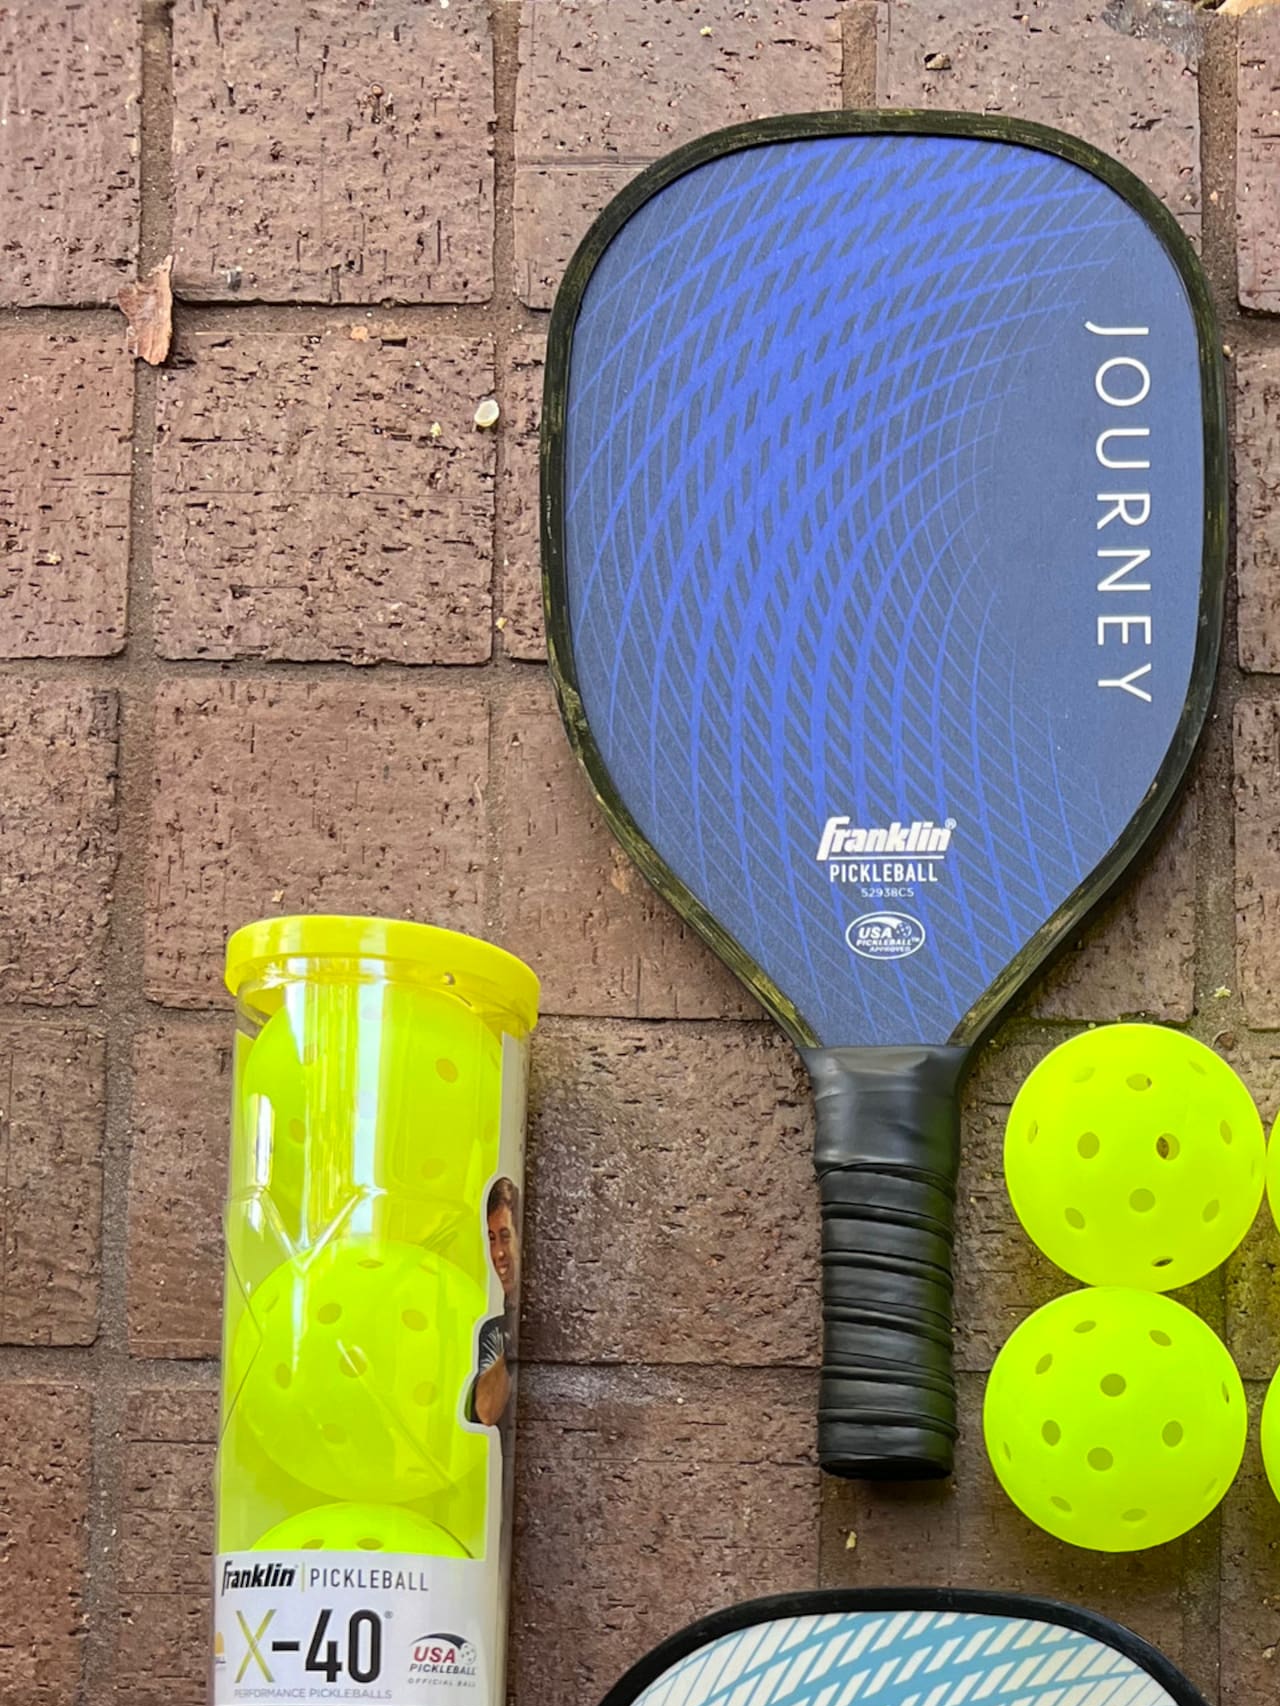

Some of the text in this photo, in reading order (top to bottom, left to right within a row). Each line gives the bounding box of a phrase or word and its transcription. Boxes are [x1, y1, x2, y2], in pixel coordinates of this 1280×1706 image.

[1085, 320, 1153, 702] JOURNEY
[829, 863, 938, 883] PICKLEBALL
[858, 926, 893, 939] USA
[856, 938, 912, 947] PICKLEBALL
[310, 1567, 429, 1592] PICKLEBALL
[413, 1646, 455, 1664] USA
[409, 1663, 476, 1676] PICKLEBALL
[234, 1687, 392, 1699] PERFORMANCE PICKLEBALLS
